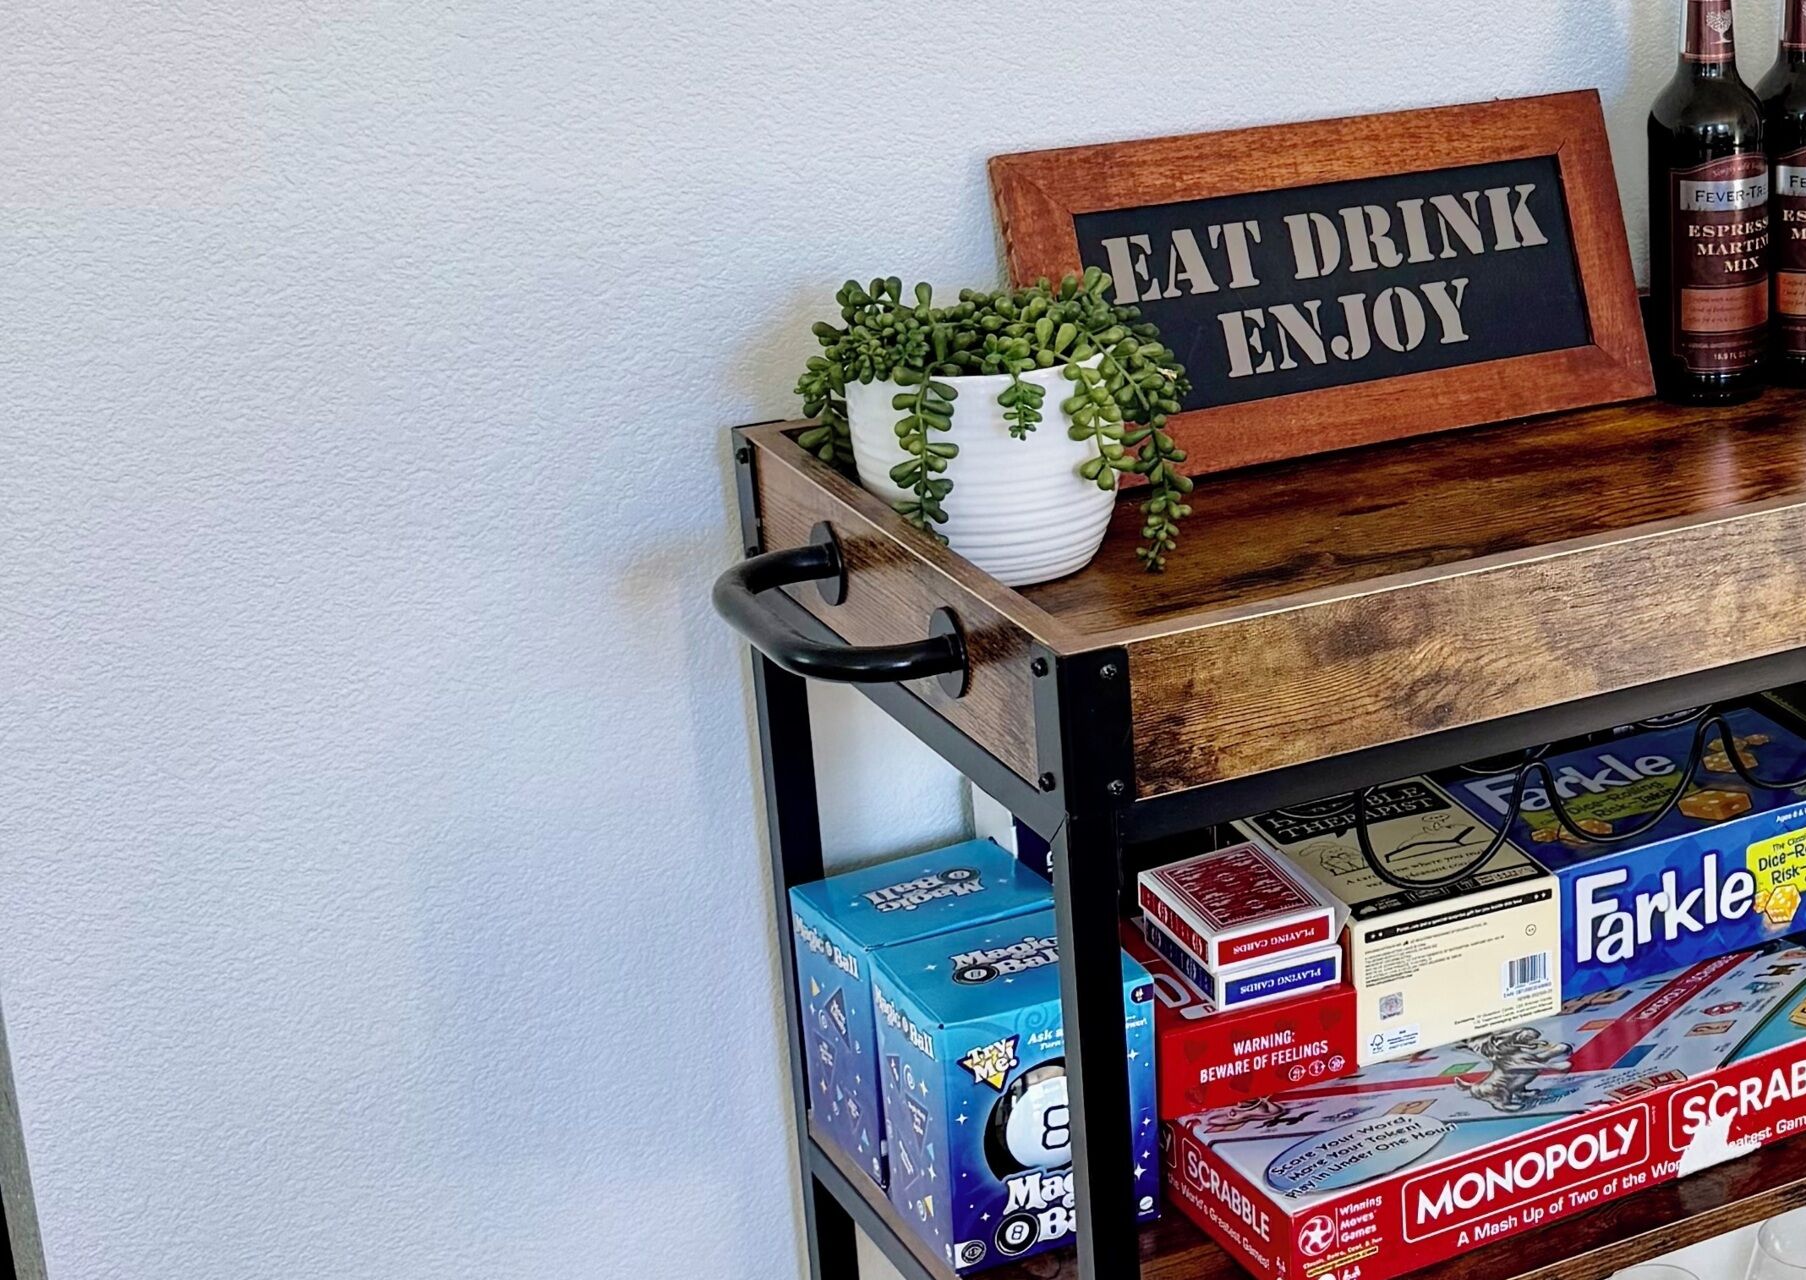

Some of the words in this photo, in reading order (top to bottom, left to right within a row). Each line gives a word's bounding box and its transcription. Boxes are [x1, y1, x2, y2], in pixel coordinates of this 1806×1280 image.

[1689, 216, 1768, 238] ESPRESS
[1100, 219, 1262, 307] EAT
[1282, 182, 1549, 281] DRINK
[1697, 232, 1768, 256] MARTIN
[1724, 256, 1760, 273] MIX
[1217, 276, 1470, 379] ENJOY
[1466, 754, 1676, 816] Farkle
[863, 875, 945, 904] Ball
[876, 879, 985, 912] Magic
[1575, 853, 1755, 964] Farkle
[950, 936, 1057, 970] Magic
[1233, 938, 1268, 955] CARDS
[1271, 927, 1315, 946] PLAYING
[834, 946, 860, 981] Ball
[1277, 967, 1322, 986] PLAYING
[1240, 979, 1275, 994] CARDS
[910, 1021, 936, 1060] Ball
[967, 1039, 1006, 1061] Try
[1027, 1029, 1053, 1045] Ask
[1233, 1030, 1296, 1056] WARNING:
[973, 1046, 1017, 1083] Me!
[1200, 1059, 1250, 1083] BEWARE
[1253, 1054, 1268, 1070] OF
[1271, 1040, 1328, 1066] FEELINGS
[1271, 1150, 1316, 1176] Score
[1316, 1134, 1354, 1151] Your
[1357, 1116, 1412, 1135] Word,
[1288, 1159, 1327, 1182] Move
[1327, 1142, 1363, 1160] Your
[1332, 1150, 1373, 1173] Under
[1375, 1138, 1409, 1152] One
[1417, 1119, 1638, 1224] MONOPOLY
[1187, 1151, 1270, 1242] SCRABBLE
[1339, 1195, 1382, 1216] Winning
[1457, 1231, 1470, 1247] A
[1474, 1215, 1518, 1241] Mash
[1523, 1207, 1544, 1225] Up
[1549, 1196, 1564, 1214] of
[1568, 1188, 1598, 1207] Two
[1603, 1178, 1618, 1196] of
[1622, 1171, 1646, 1190] the
[1340, 1211, 1374, 1230] Moves
[1341, 1224, 1377, 1242] Games
